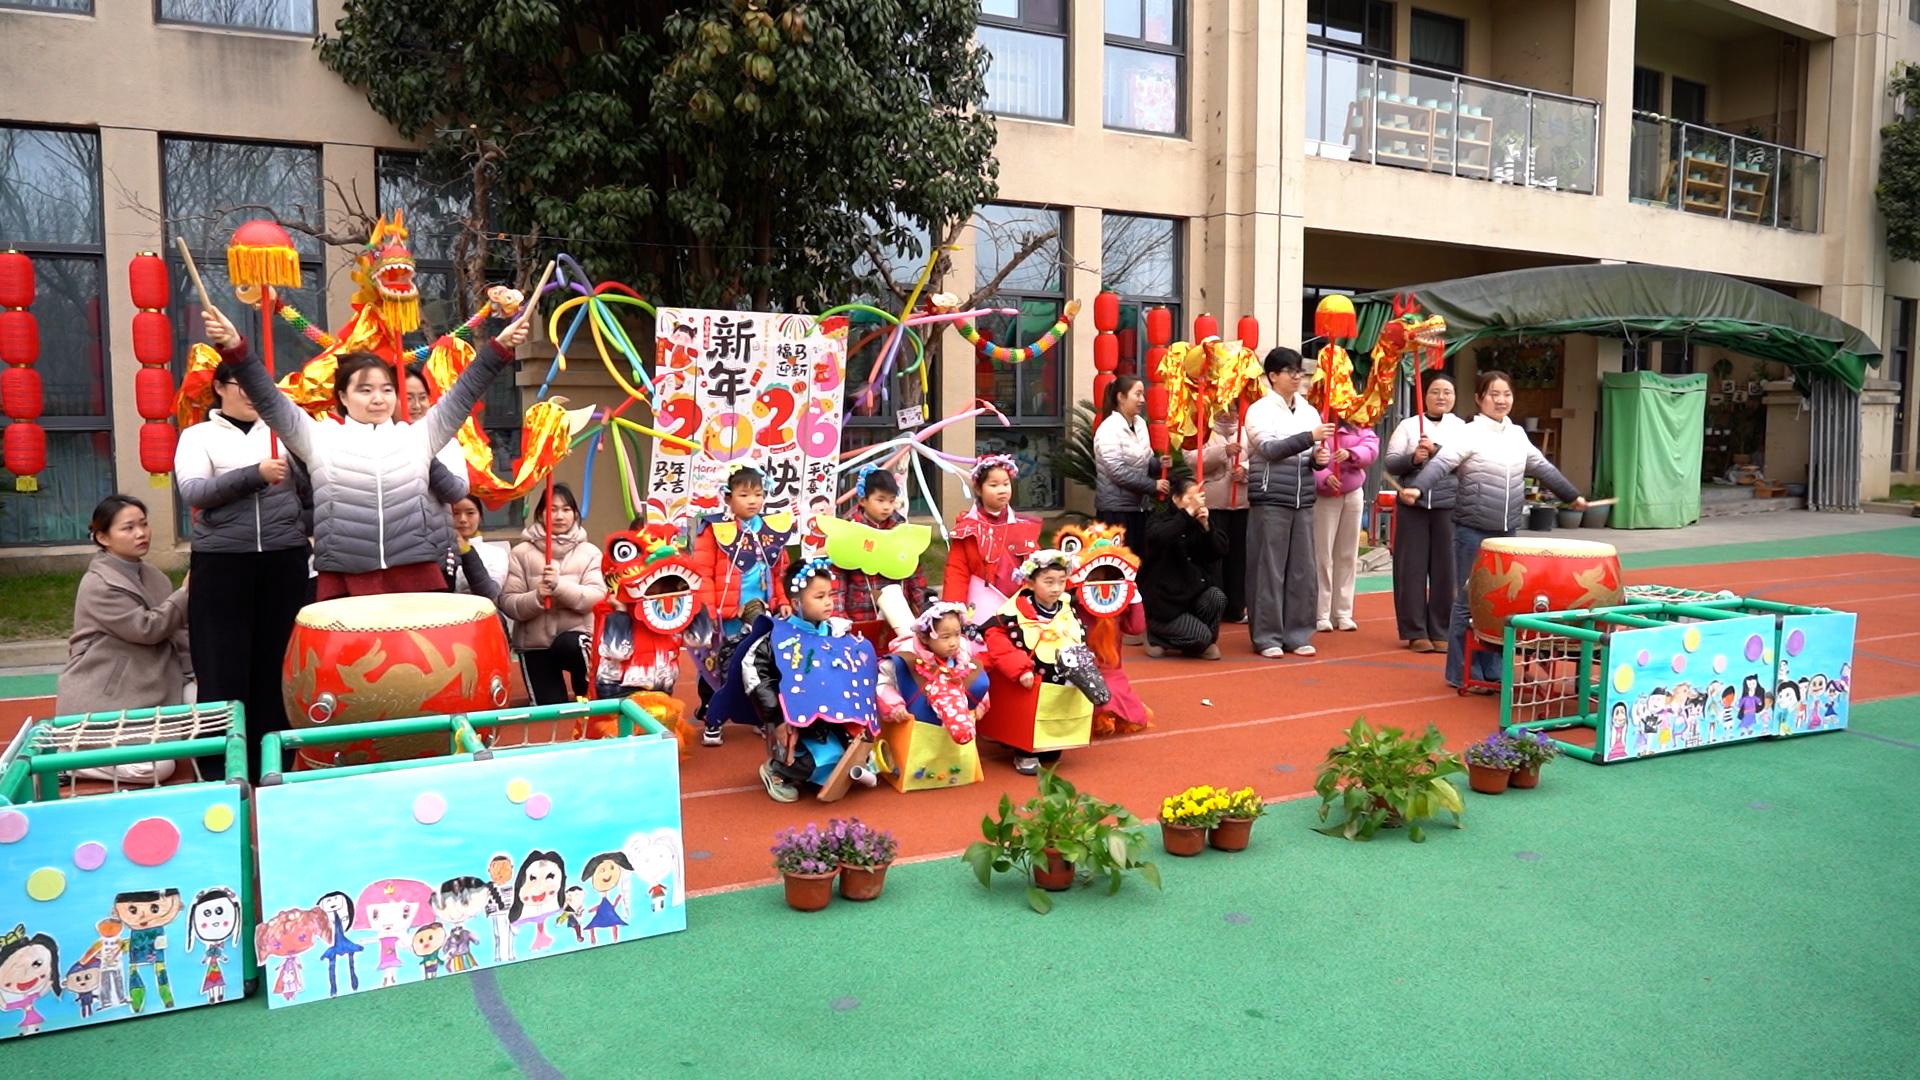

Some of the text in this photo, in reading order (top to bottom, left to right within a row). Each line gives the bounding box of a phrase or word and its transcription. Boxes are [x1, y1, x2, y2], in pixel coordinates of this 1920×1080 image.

[706, 315, 756, 407] 新年
[776, 343, 807, 362] 福马
[776, 361, 808, 378] 迎新
[657, 382, 839, 462] 2026
[654, 461, 686, 476] 马年
[653, 479, 684, 494] 大吉
